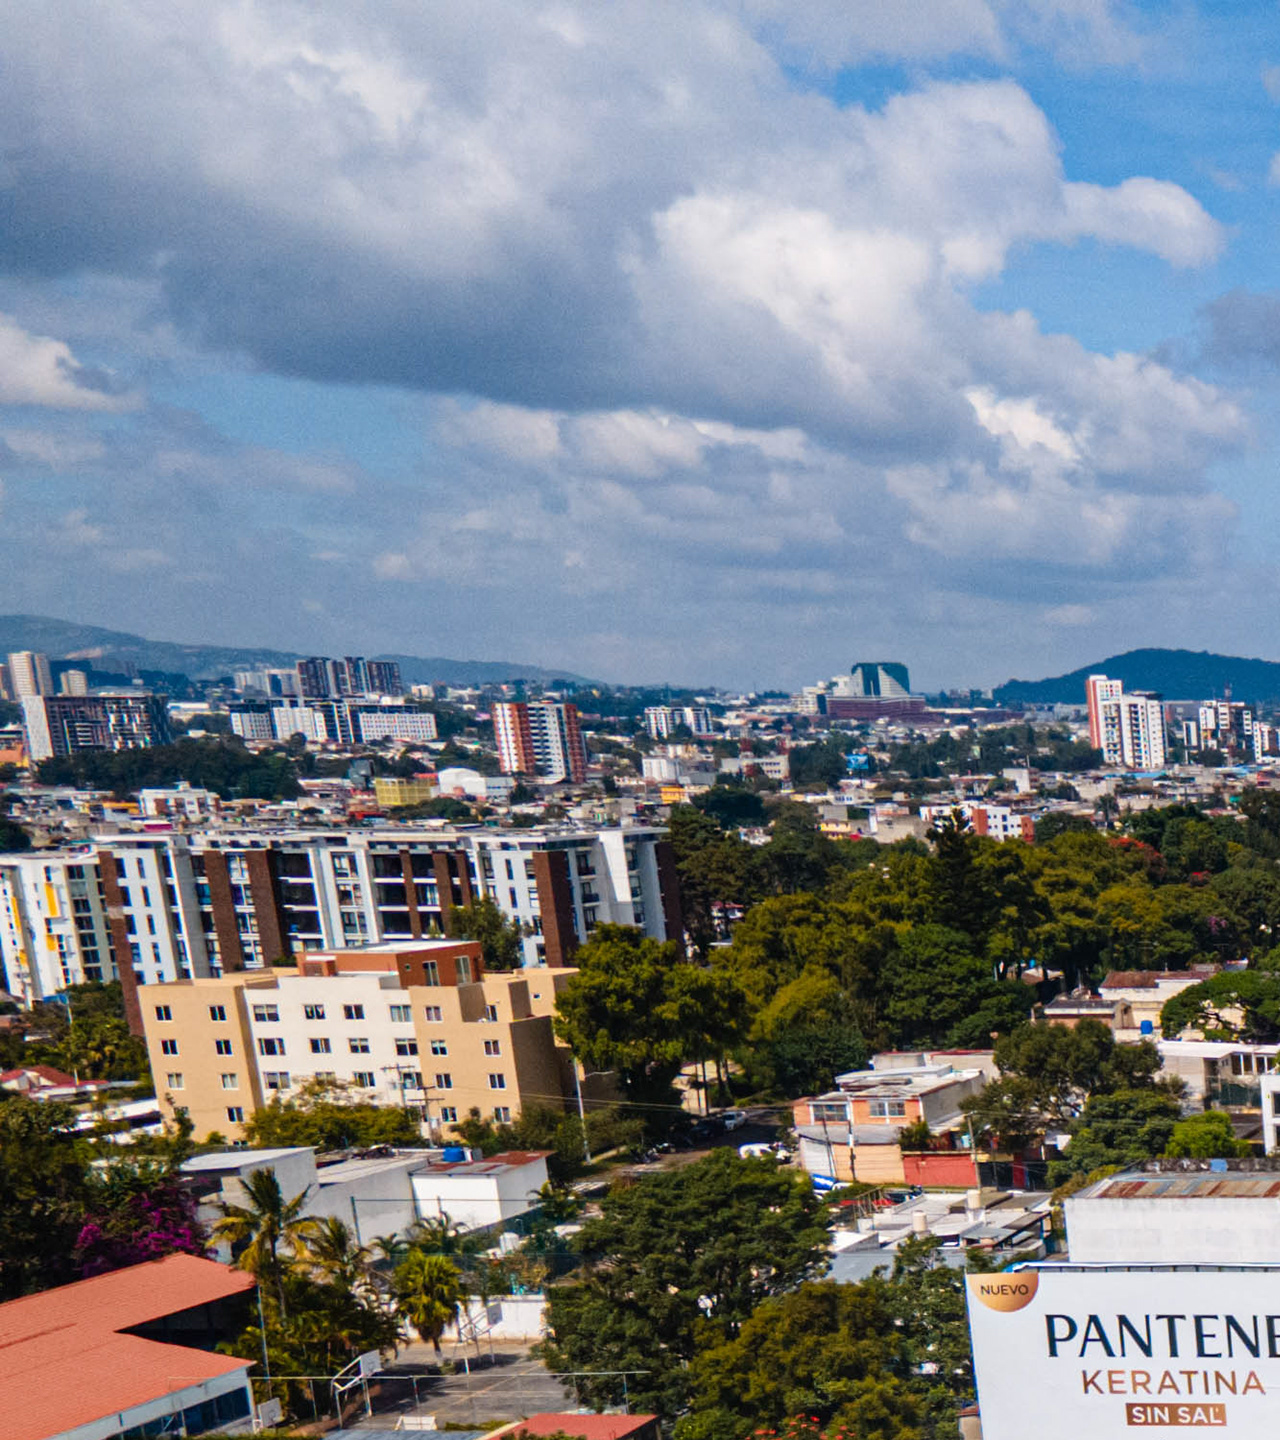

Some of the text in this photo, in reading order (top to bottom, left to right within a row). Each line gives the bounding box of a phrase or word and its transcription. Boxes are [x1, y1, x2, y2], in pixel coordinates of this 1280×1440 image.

[980, 1284, 1030, 1297] NUEVO
[1082, 1369, 1266, 1395] KERATINA
[1132, 1407, 1171, 1424] SIN
